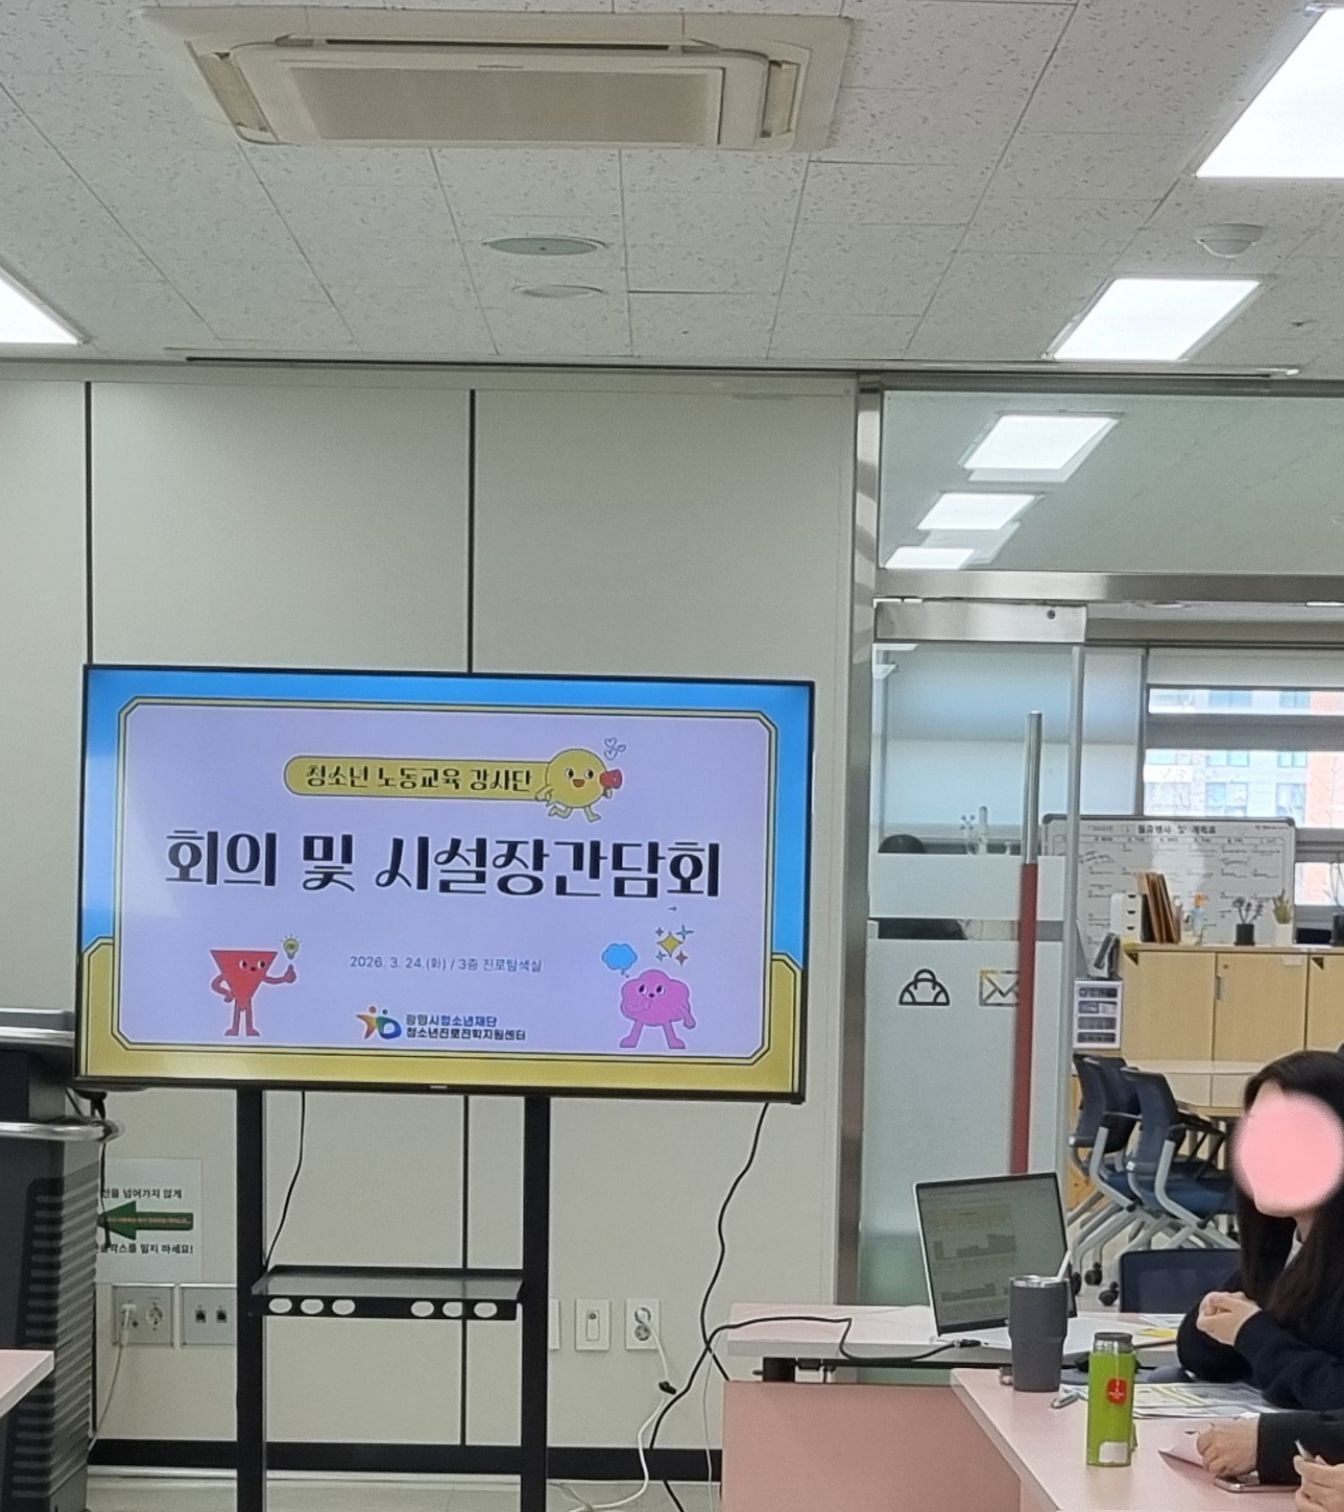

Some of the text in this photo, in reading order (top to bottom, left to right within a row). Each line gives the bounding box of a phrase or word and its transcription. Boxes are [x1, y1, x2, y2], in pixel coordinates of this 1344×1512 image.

[306, 764, 532, 792] 청소년 노동교육 강사단
[165, 829, 720, 898] 회의 및 시설장간담회
[459, 958, 478, 971] 3층
[483, 958, 541, 973] 진로탐색실
[406, 1014, 497, 1027] 광명시청소년재단
[406, 1027, 526, 1041] 청소년진로진학지원센터
[123, 1188, 161, 1199] 넘어가지
[163, 1188, 182, 1199] 않게
[161, 1244, 194, 1255] 마세요!
